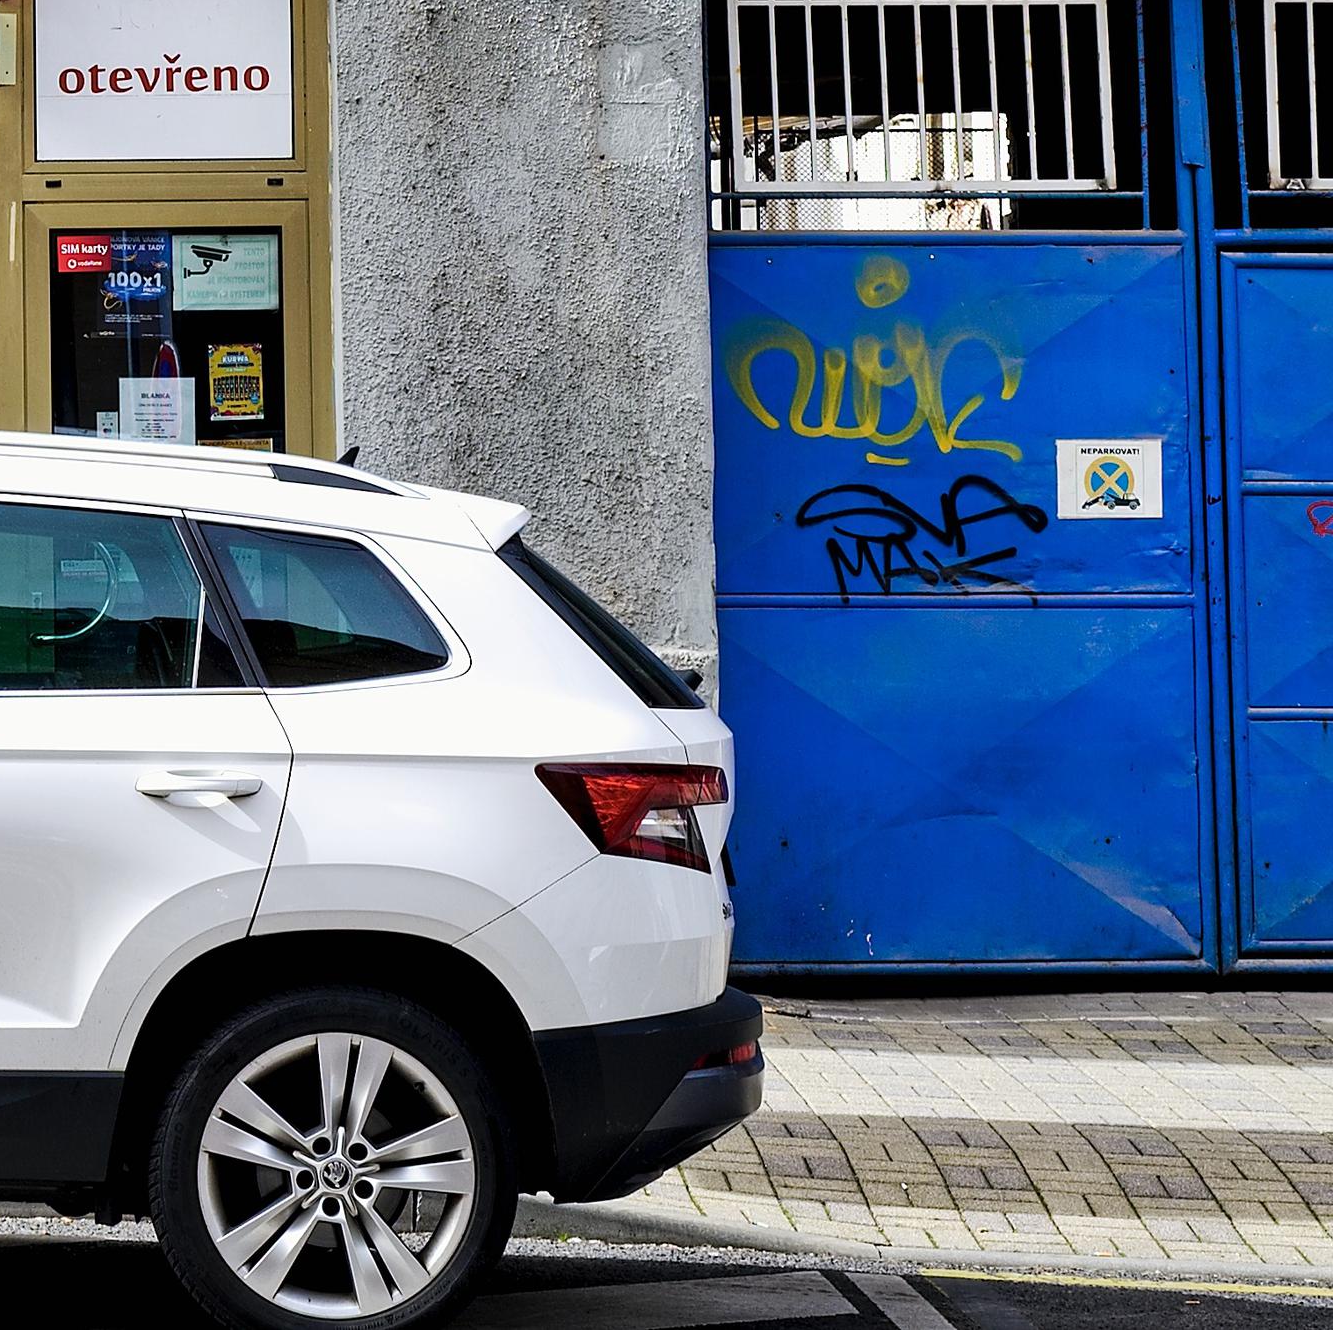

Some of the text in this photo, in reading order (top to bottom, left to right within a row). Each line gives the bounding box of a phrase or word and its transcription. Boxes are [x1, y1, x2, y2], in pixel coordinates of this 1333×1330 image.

[59, 52, 271, 94] otevřeno
[61, 243, 108, 256] SIM karty
[1080, 447, 1140, 455] NEPARKOVAT!
